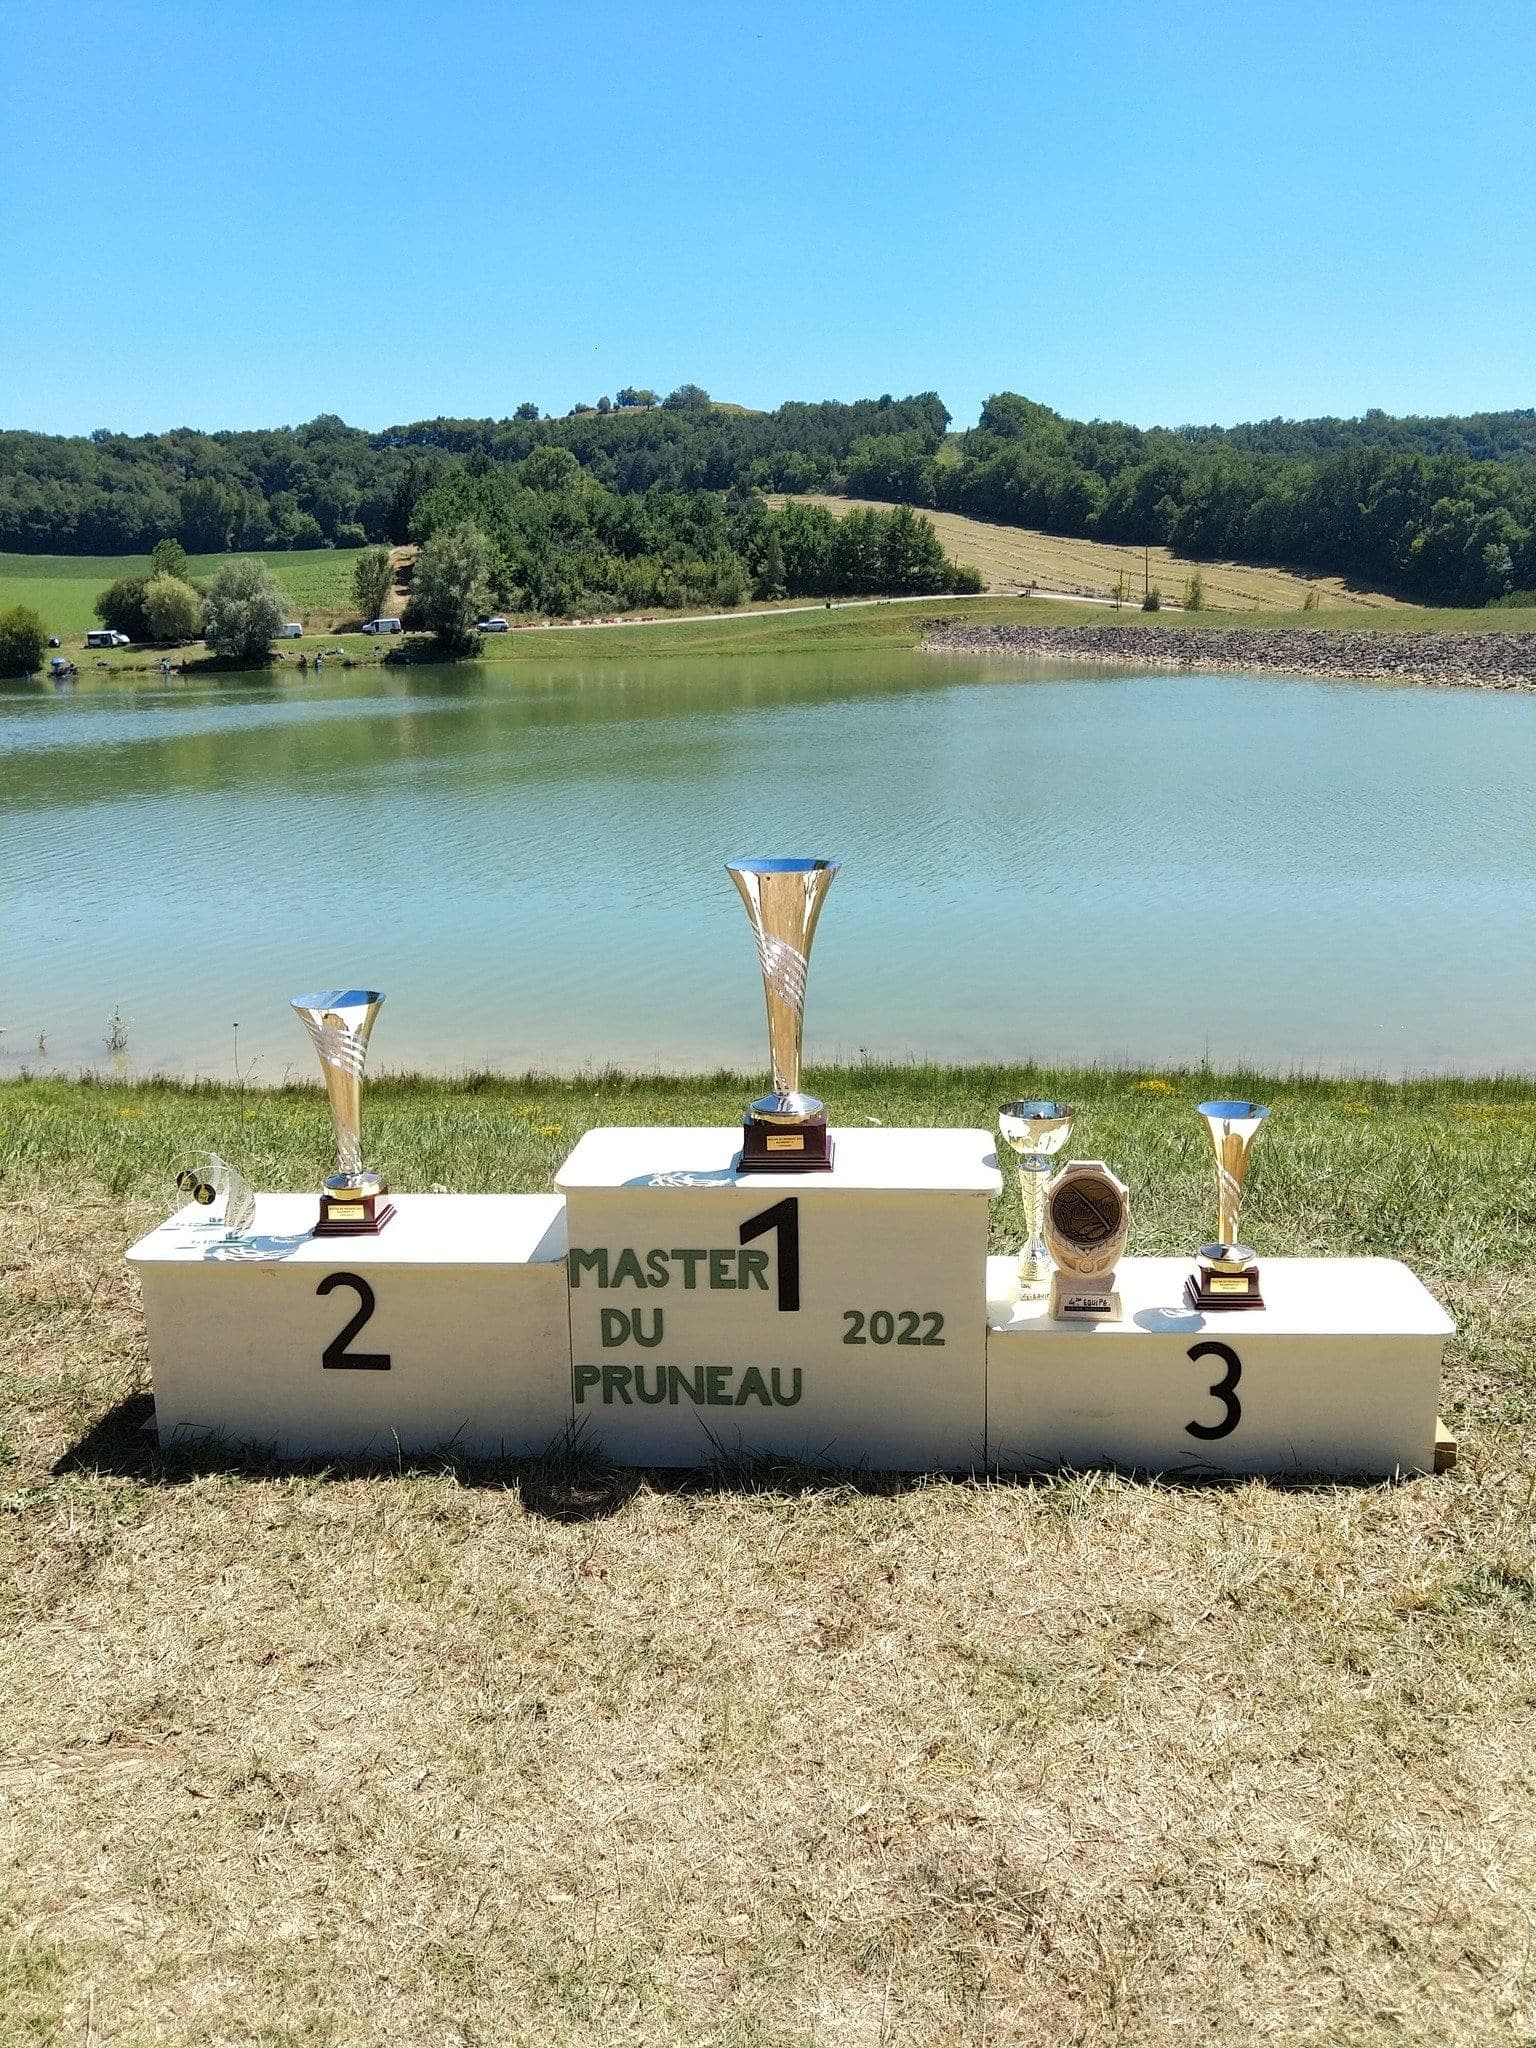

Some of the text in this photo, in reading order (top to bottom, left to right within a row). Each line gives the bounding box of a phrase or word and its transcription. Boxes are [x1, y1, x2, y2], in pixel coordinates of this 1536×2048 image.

[570, 1248, 769, 1290] MASTER
[740, 1198, 799, 1311] 1
[316, 1272, 391, 1370] 2
[600, 1308, 664, 1348] DU
[842, 1310, 946, 1346] 2022
[574, 1365, 802, 1407] PRUNEAU
[1185, 1342, 1241, 1440] 3
